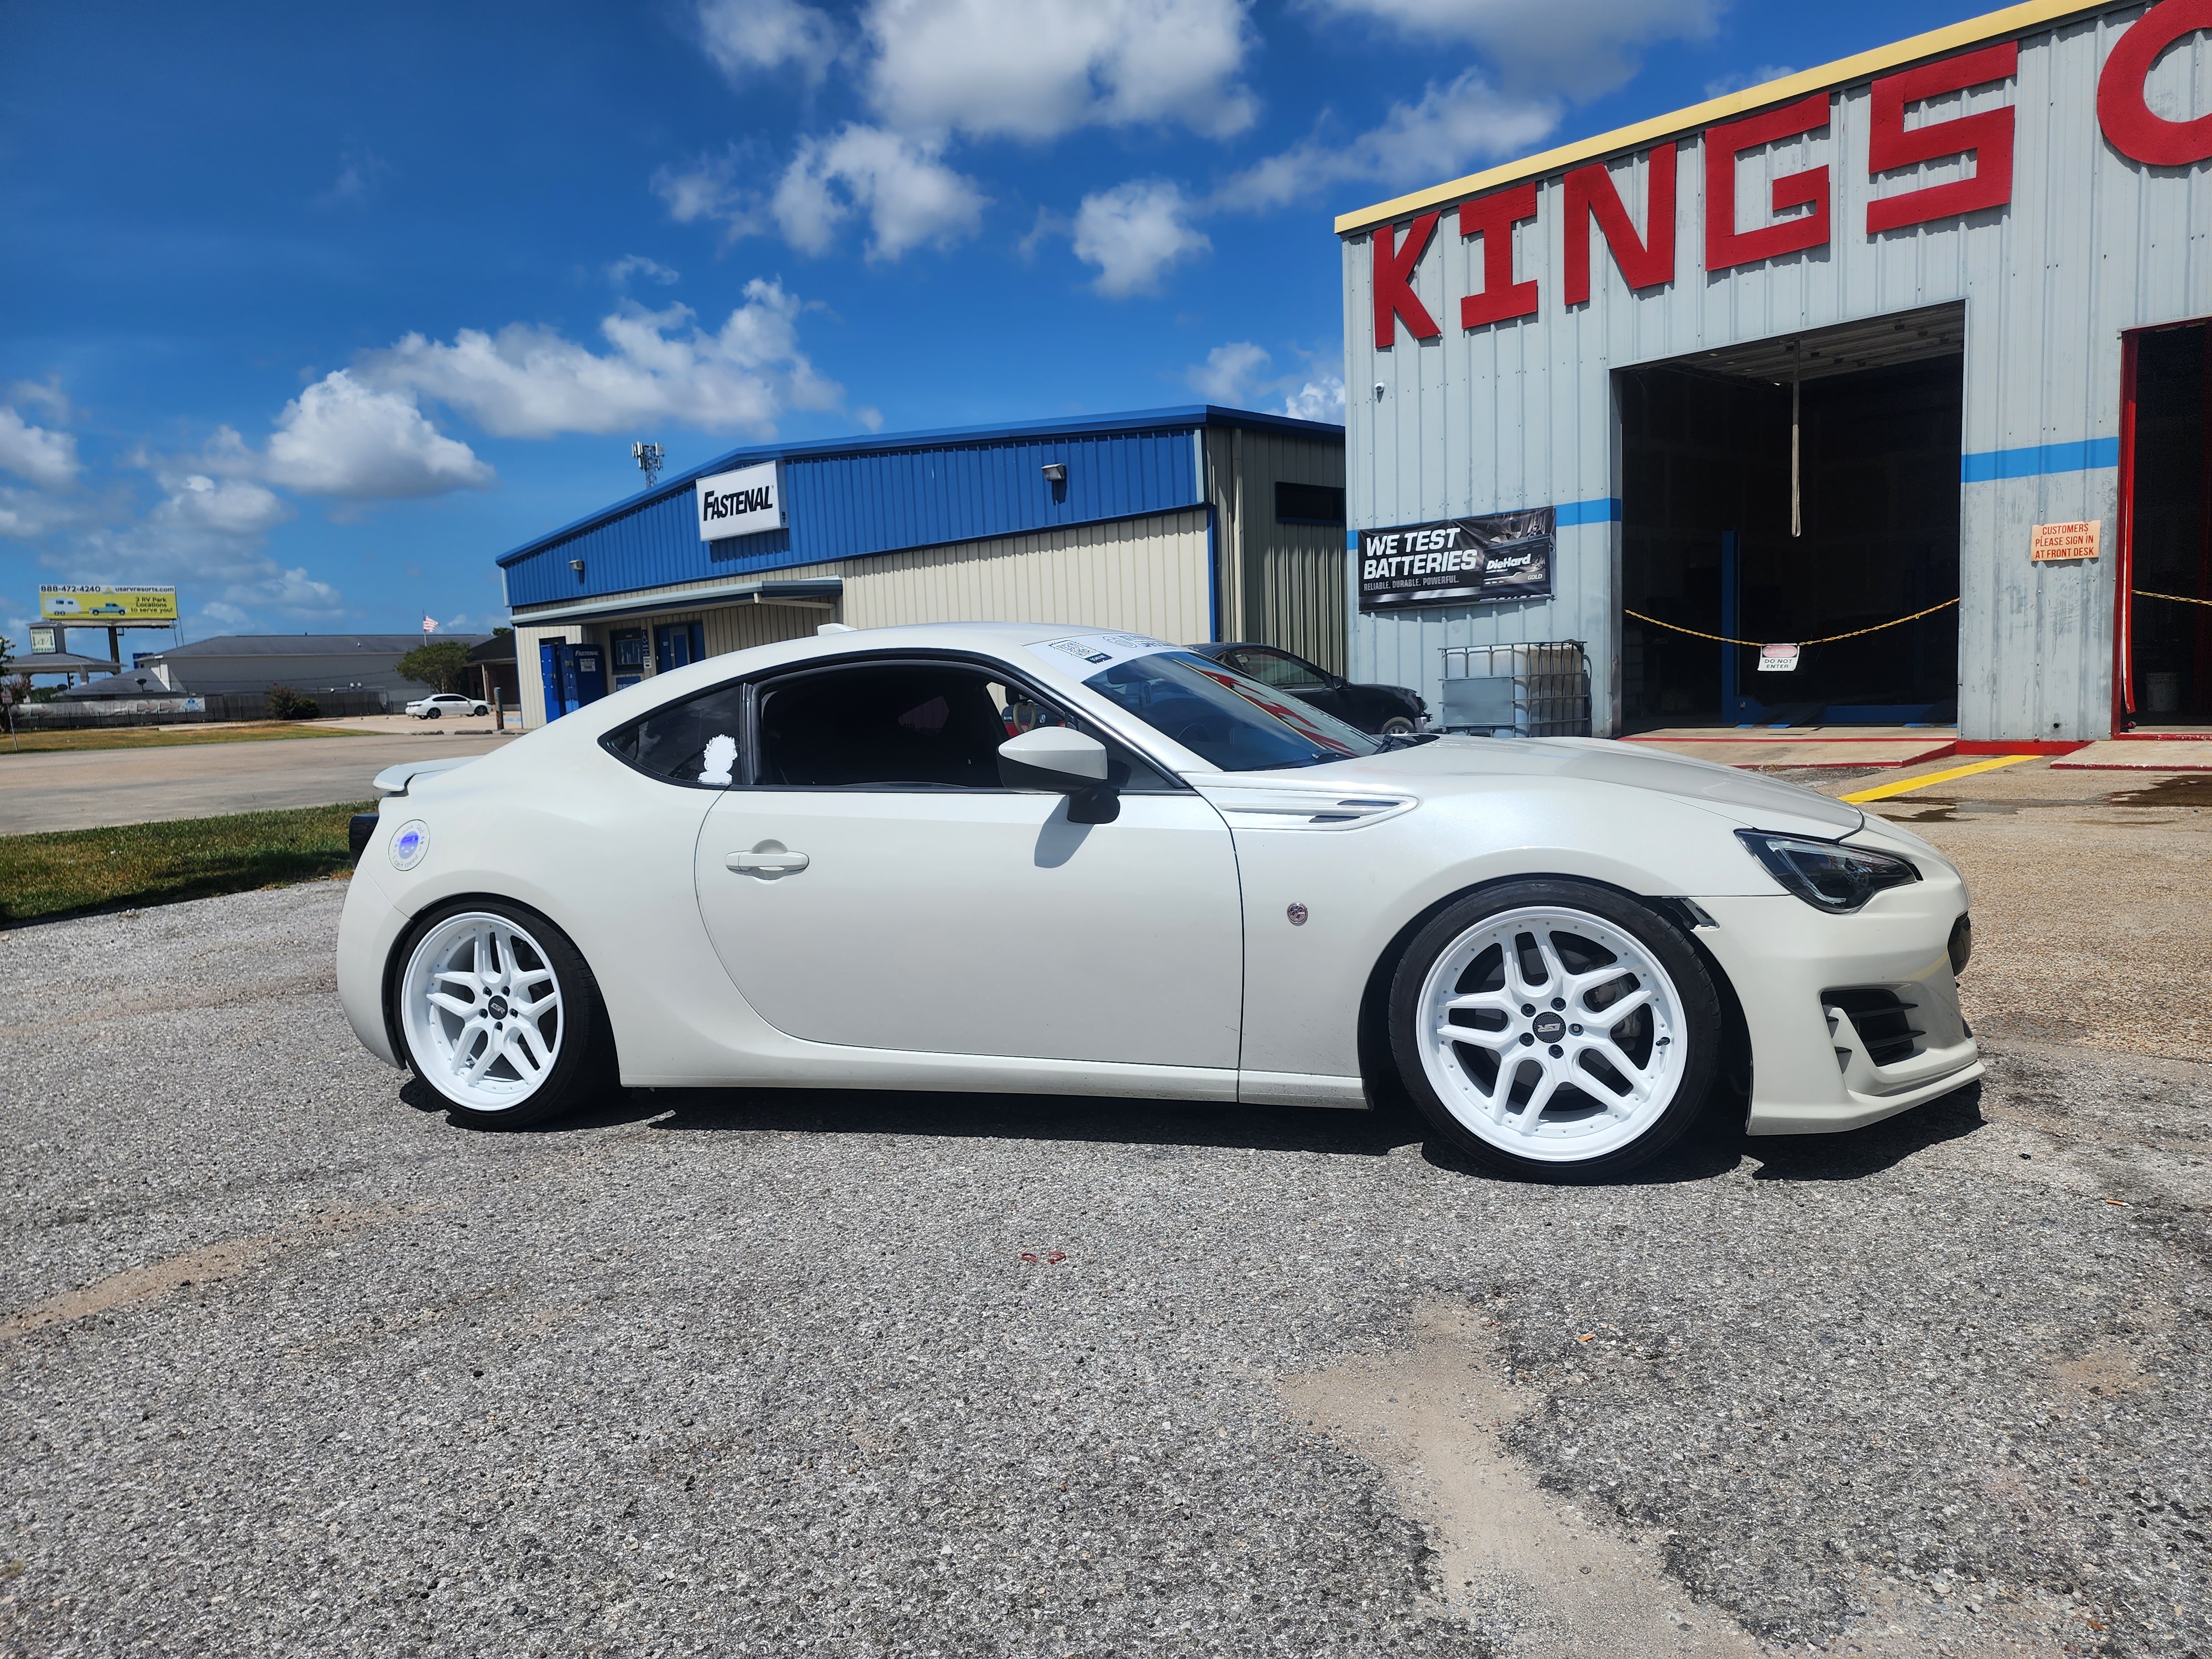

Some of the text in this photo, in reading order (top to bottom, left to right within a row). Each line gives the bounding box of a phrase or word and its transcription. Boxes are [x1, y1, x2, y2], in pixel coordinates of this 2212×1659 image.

[703, 486, 773, 521] FASTENAL
[2042, 523, 2089, 535] CUSTOMERS
[1366, 528, 1460, 557] WE TEST
[2035, 535, 2094, 547] PLEASE SIGN IN
[2035, 547, 2094, 559] AT FRONT DESK
[1363, 549, 1478, 580] BATTERIES
[1486, 553, 1531, 570] DieHard
[1364, 575, 1459, 591] RELIABLE. DURABLE. POWERFUL.
[491, 1002, 505, 1014] ESR
